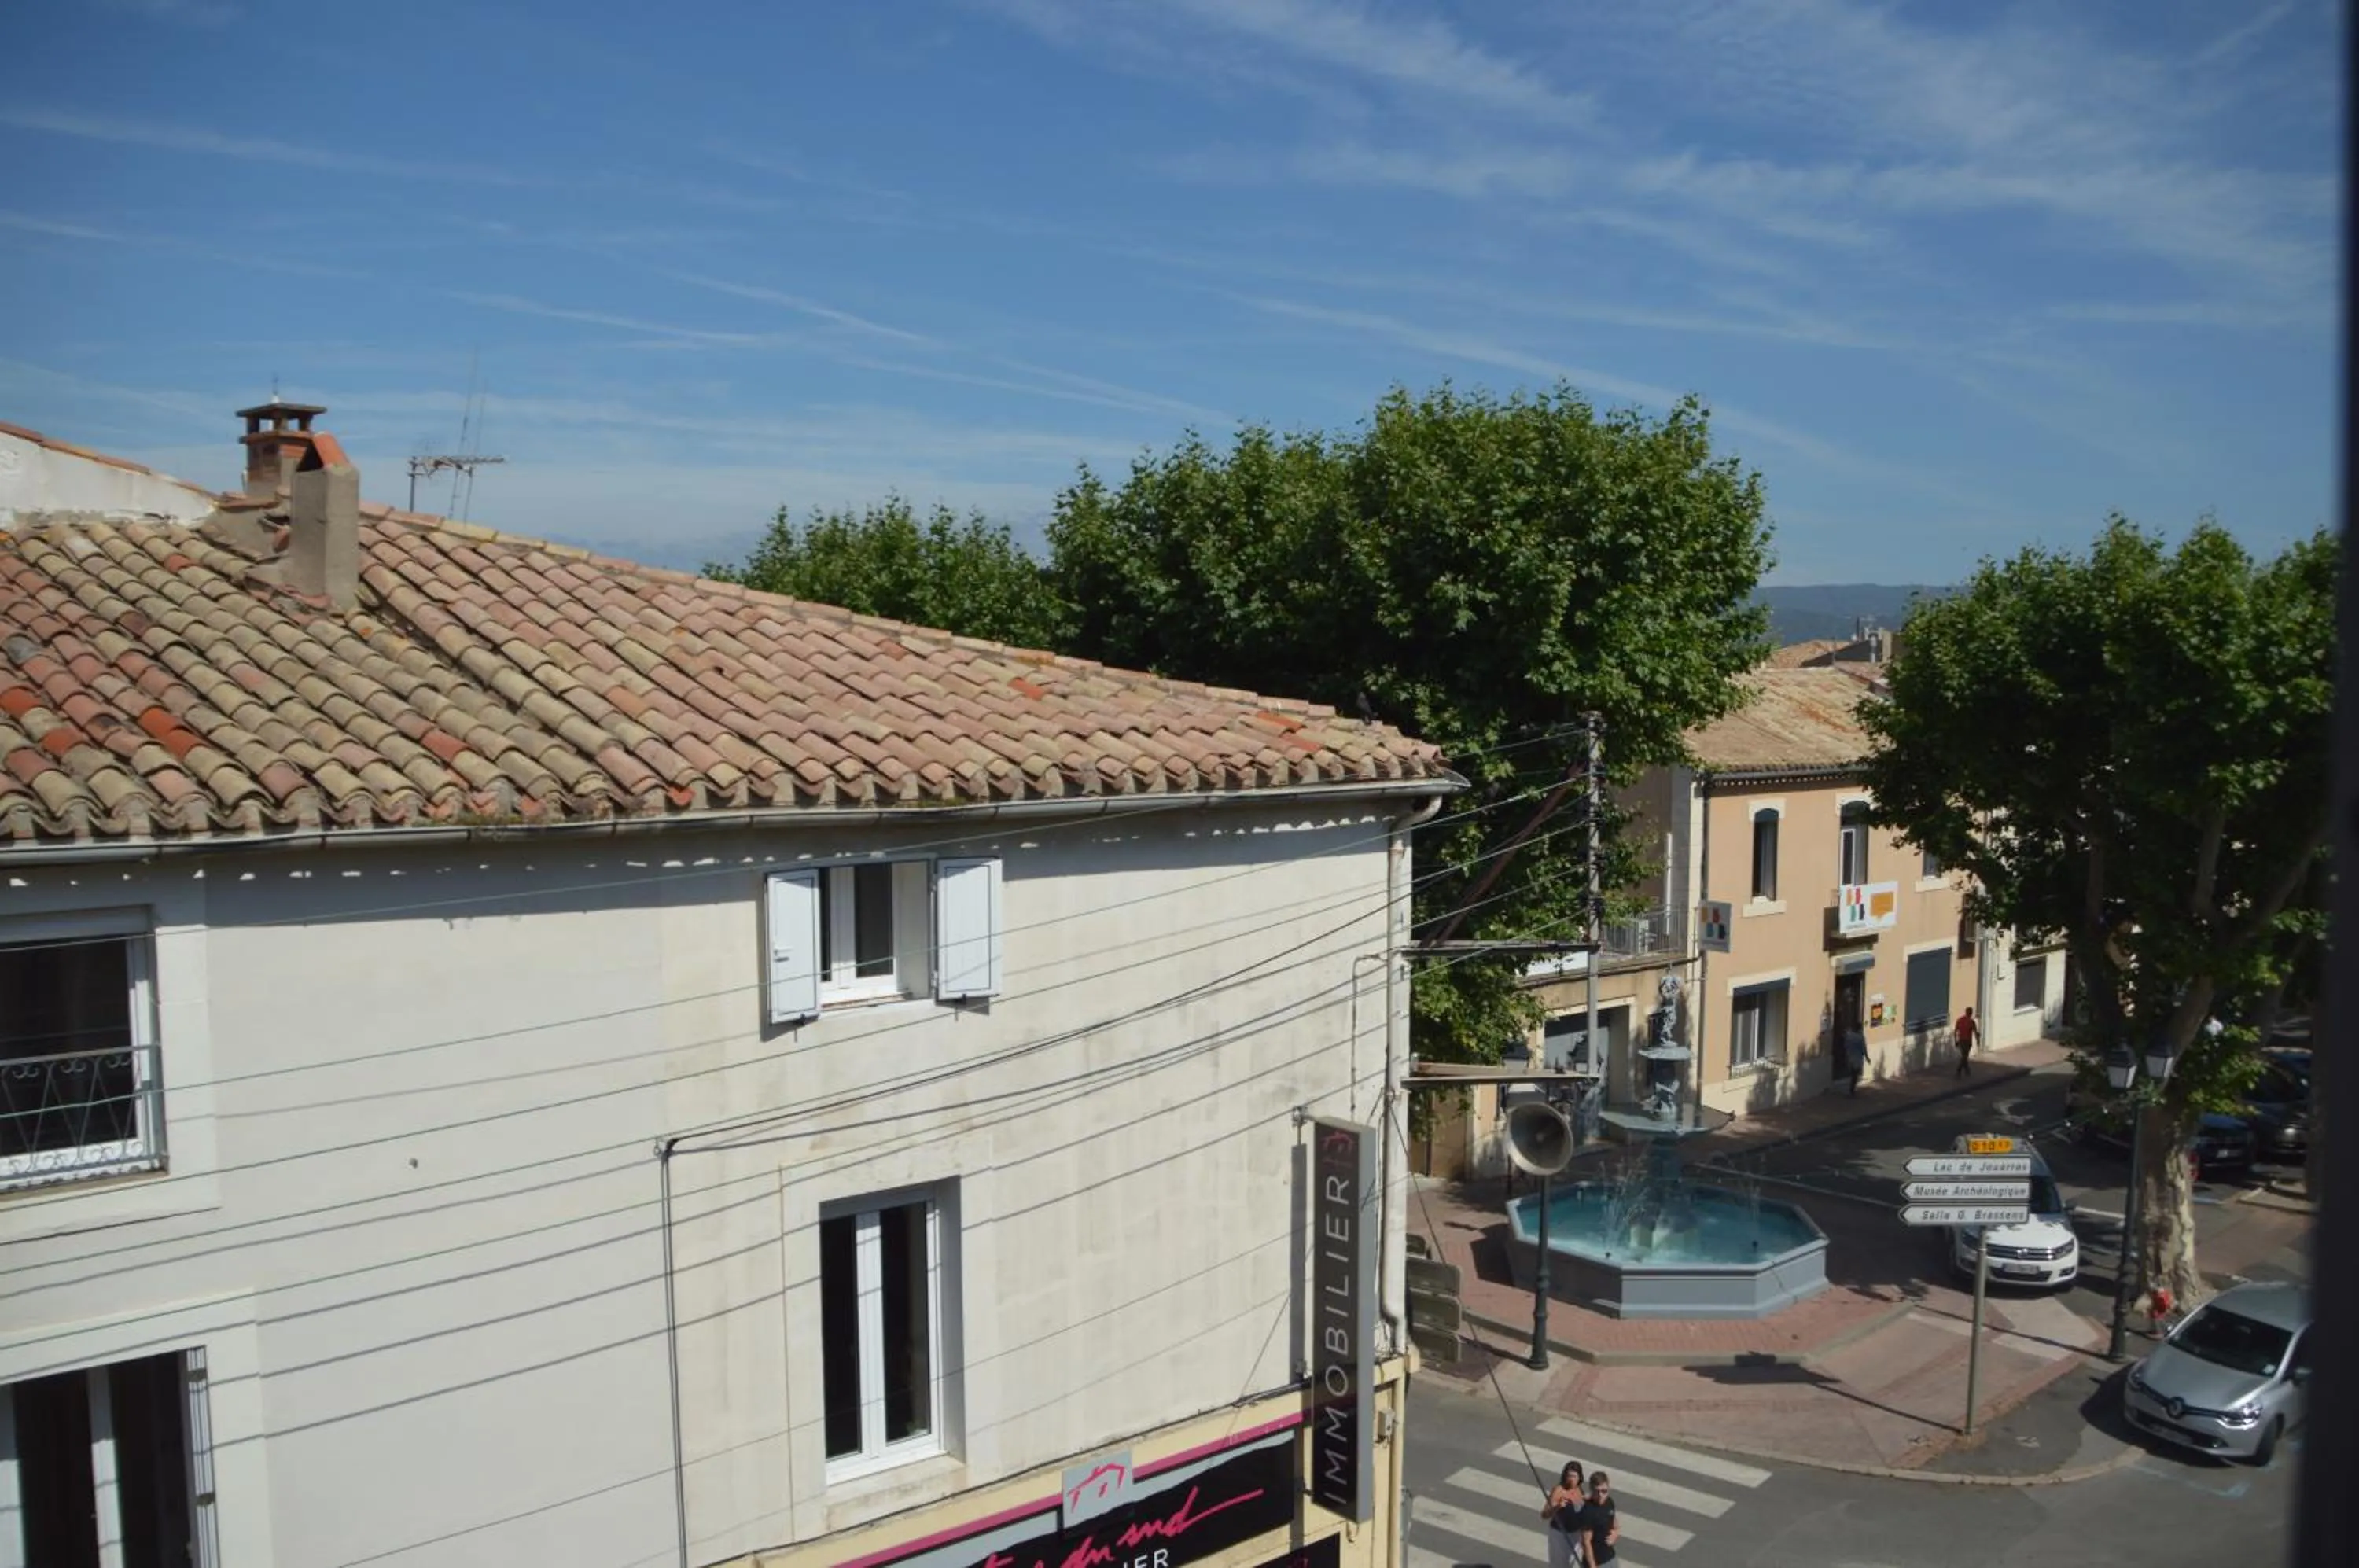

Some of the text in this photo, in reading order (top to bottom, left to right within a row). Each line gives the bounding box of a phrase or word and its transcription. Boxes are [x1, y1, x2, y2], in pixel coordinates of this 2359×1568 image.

[1933, 1161, 1952, 1172] Lac
[1959, 1161, 1972, 1172] de
[1913, 1186, 1948, 1196] Musée
[1922, 1210, 1951, 1220] Salle
[1974, 1210, 2025, 1220] Brassens
[1324, 1176, 1350, 1505] IMMOBILIER
